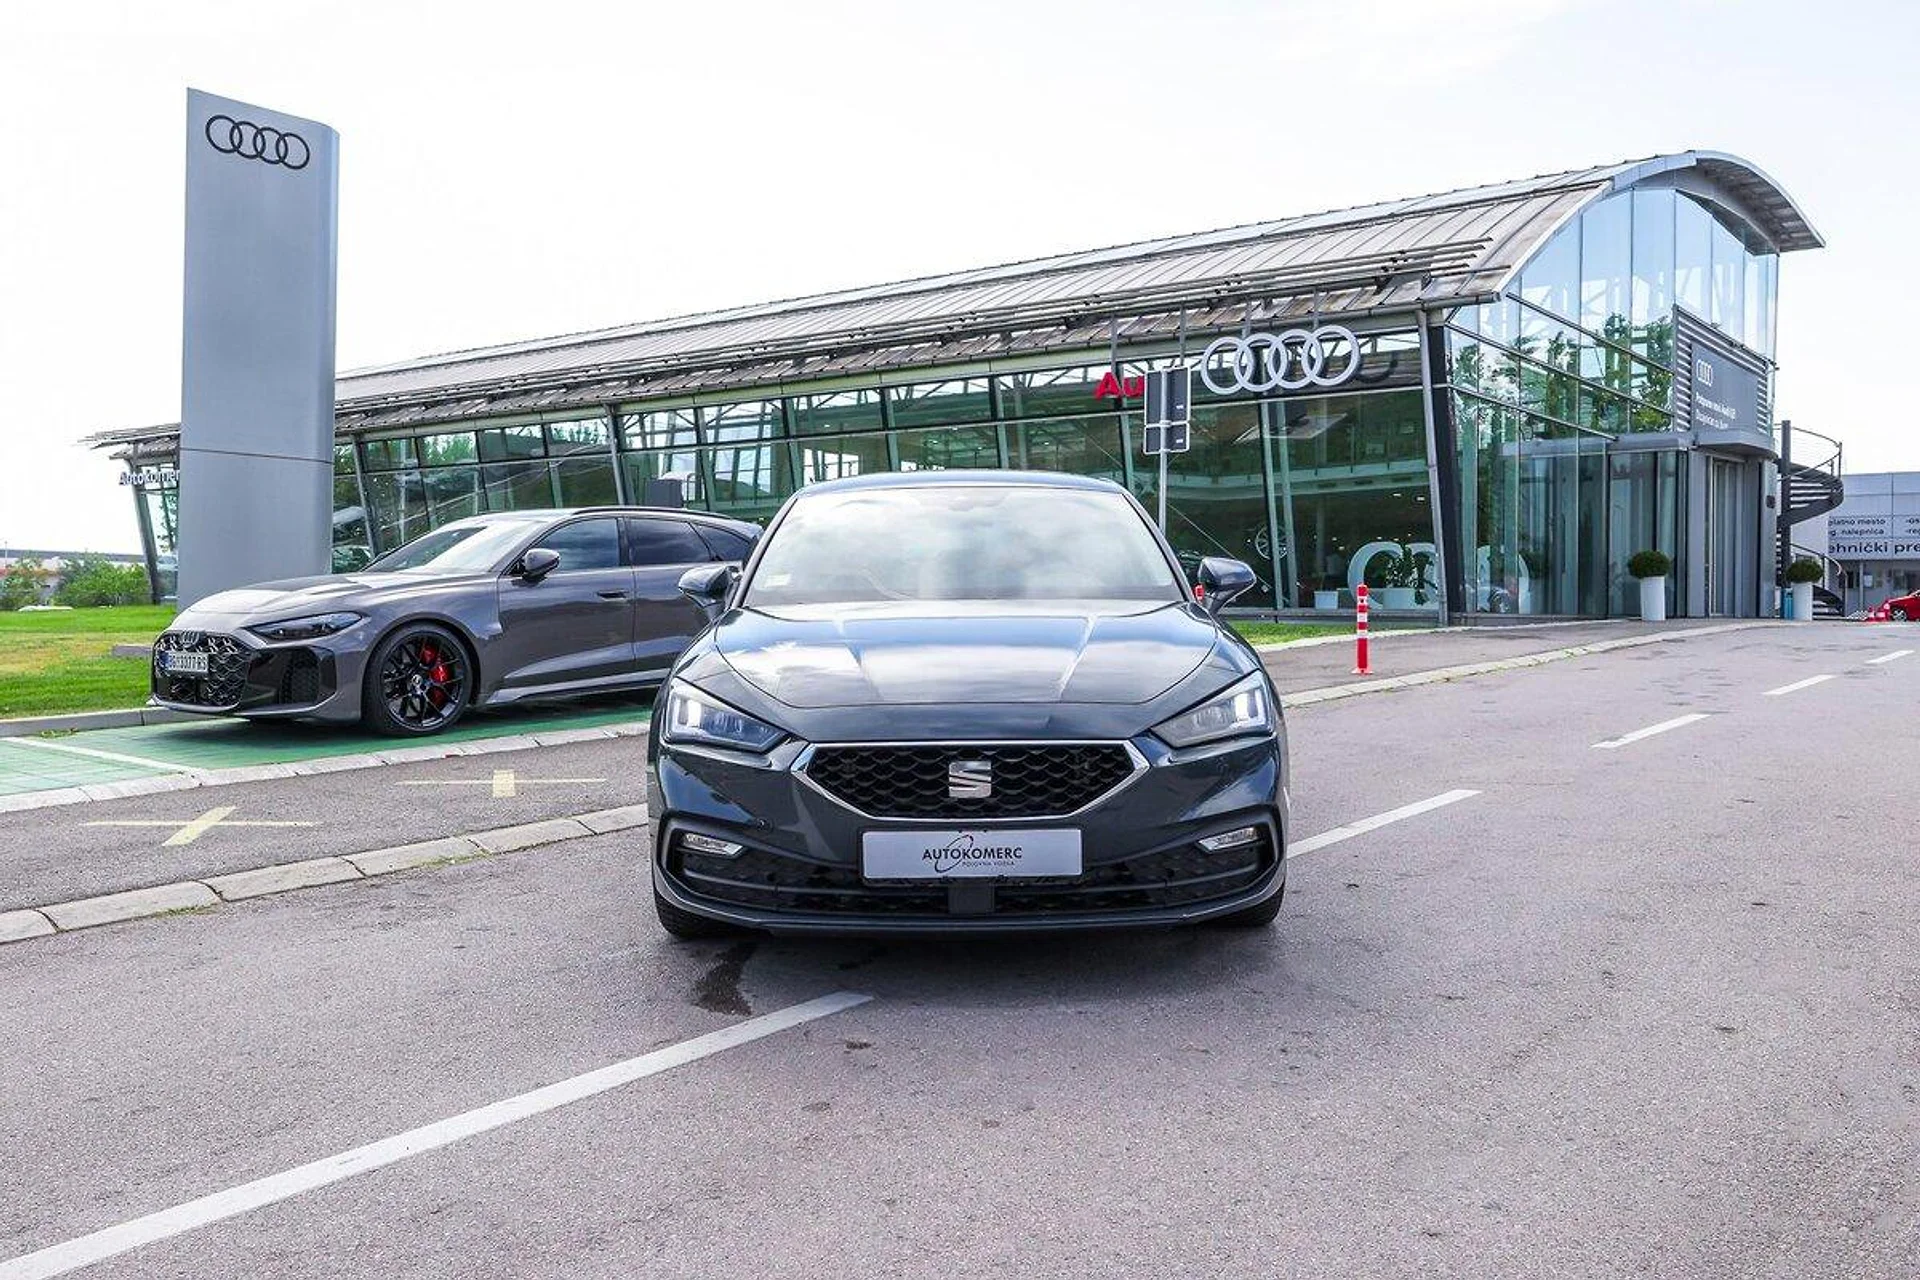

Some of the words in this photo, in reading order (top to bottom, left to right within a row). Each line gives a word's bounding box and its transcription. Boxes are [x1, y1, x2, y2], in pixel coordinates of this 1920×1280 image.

[1094, 371, 1144, 400] Au
[1857, 518, 1886, 526] mesto
[1841, 528, 1884, 536] nalepnica
[922, 847, 1022, 860] AUTOKOMERC
